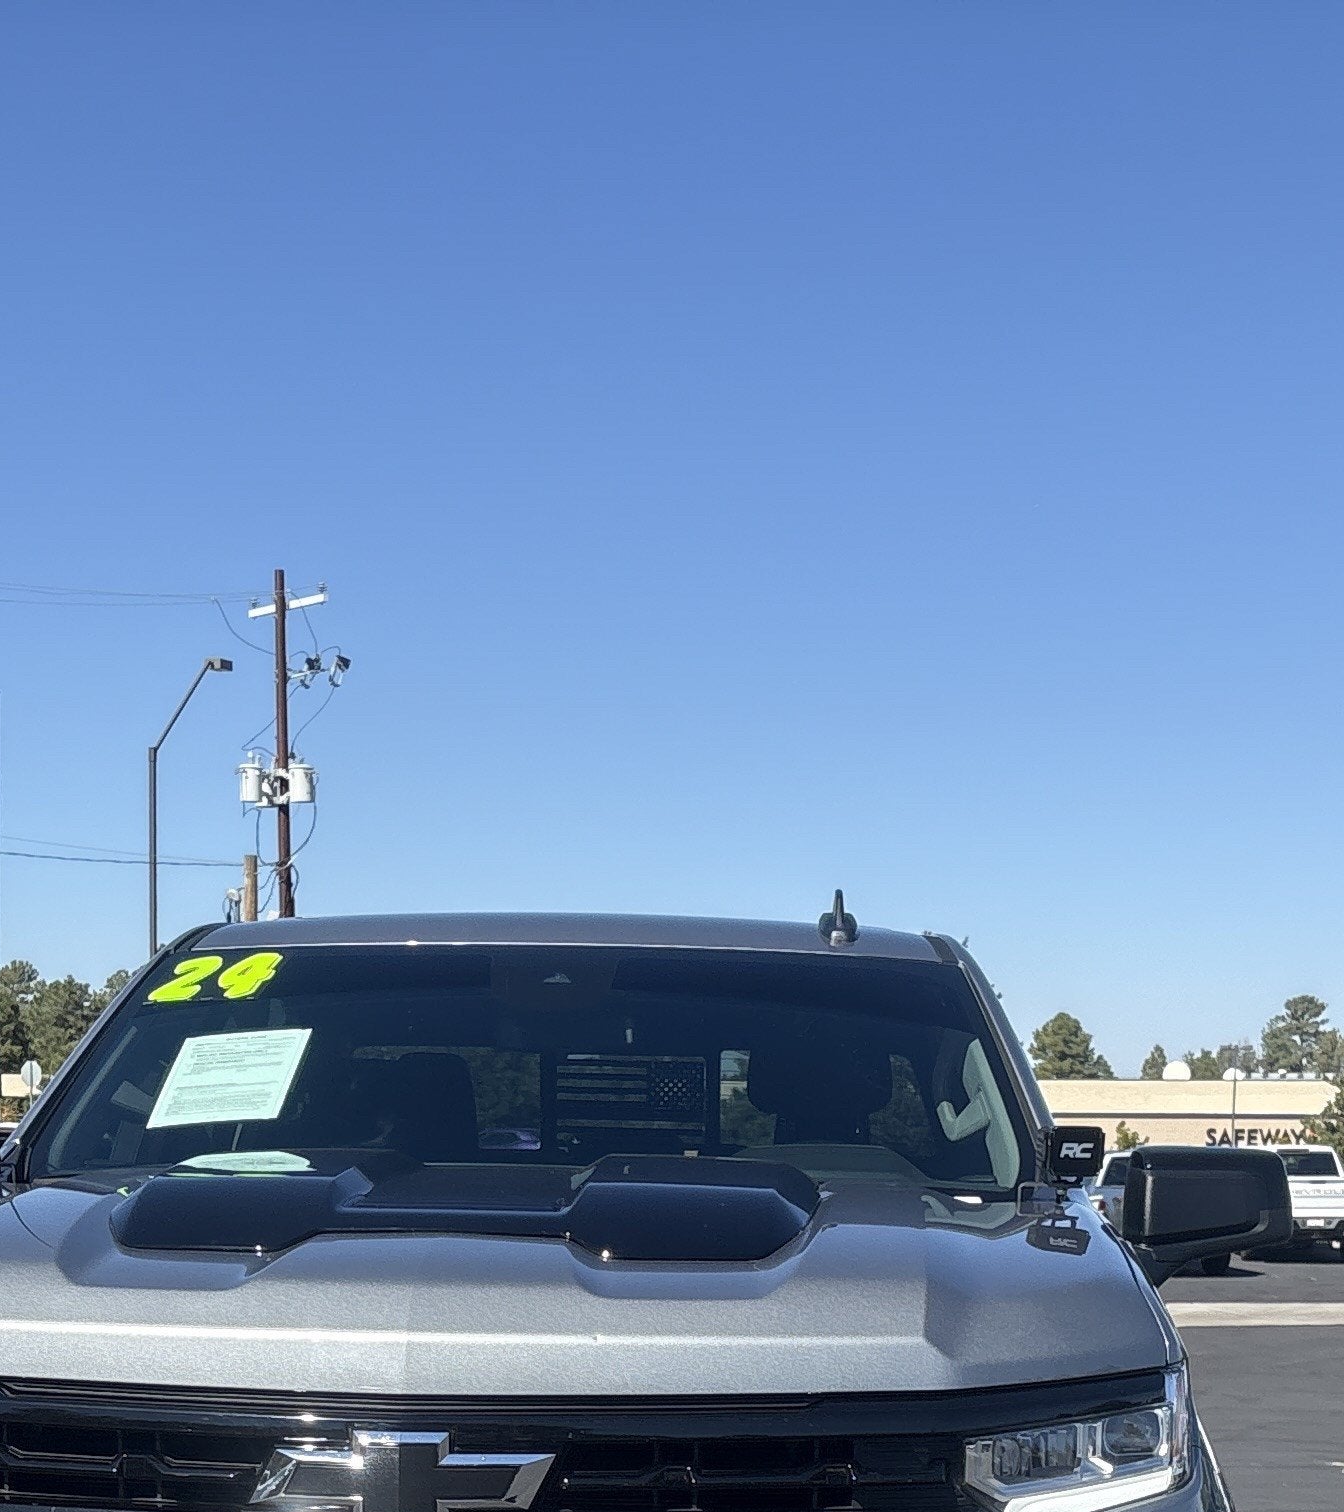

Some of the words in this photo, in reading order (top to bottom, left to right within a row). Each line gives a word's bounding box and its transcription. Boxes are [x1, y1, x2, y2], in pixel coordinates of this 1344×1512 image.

[147, 952, 284, 1003] 24
[1205, 1127, 1308, 1147] SAFEWAY
[1059, 1142, 1095, 1159] RC
